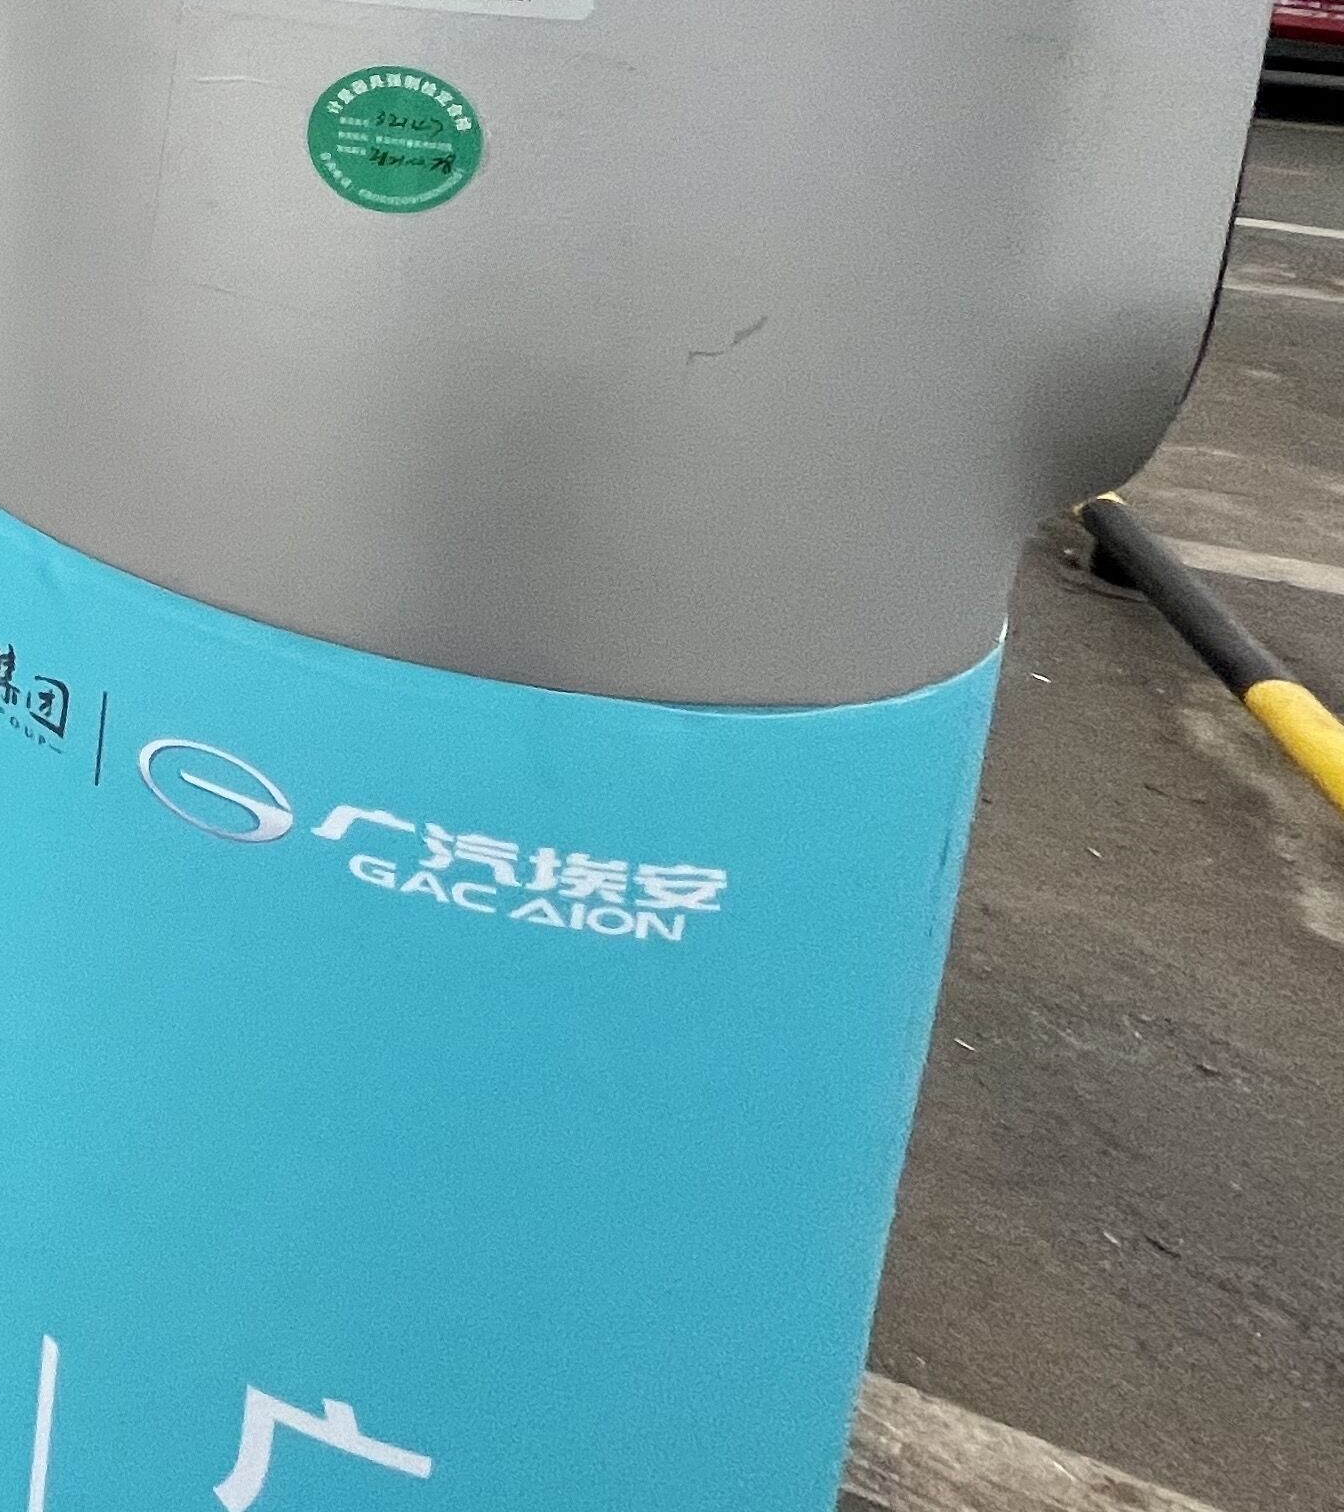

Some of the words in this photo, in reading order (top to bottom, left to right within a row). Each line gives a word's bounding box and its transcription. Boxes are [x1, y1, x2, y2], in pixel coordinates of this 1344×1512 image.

[311, 804, 728, 912] 广汽埃安
[347, 853, 499, 914] GAC
[509, 897, 686, 942] AION
